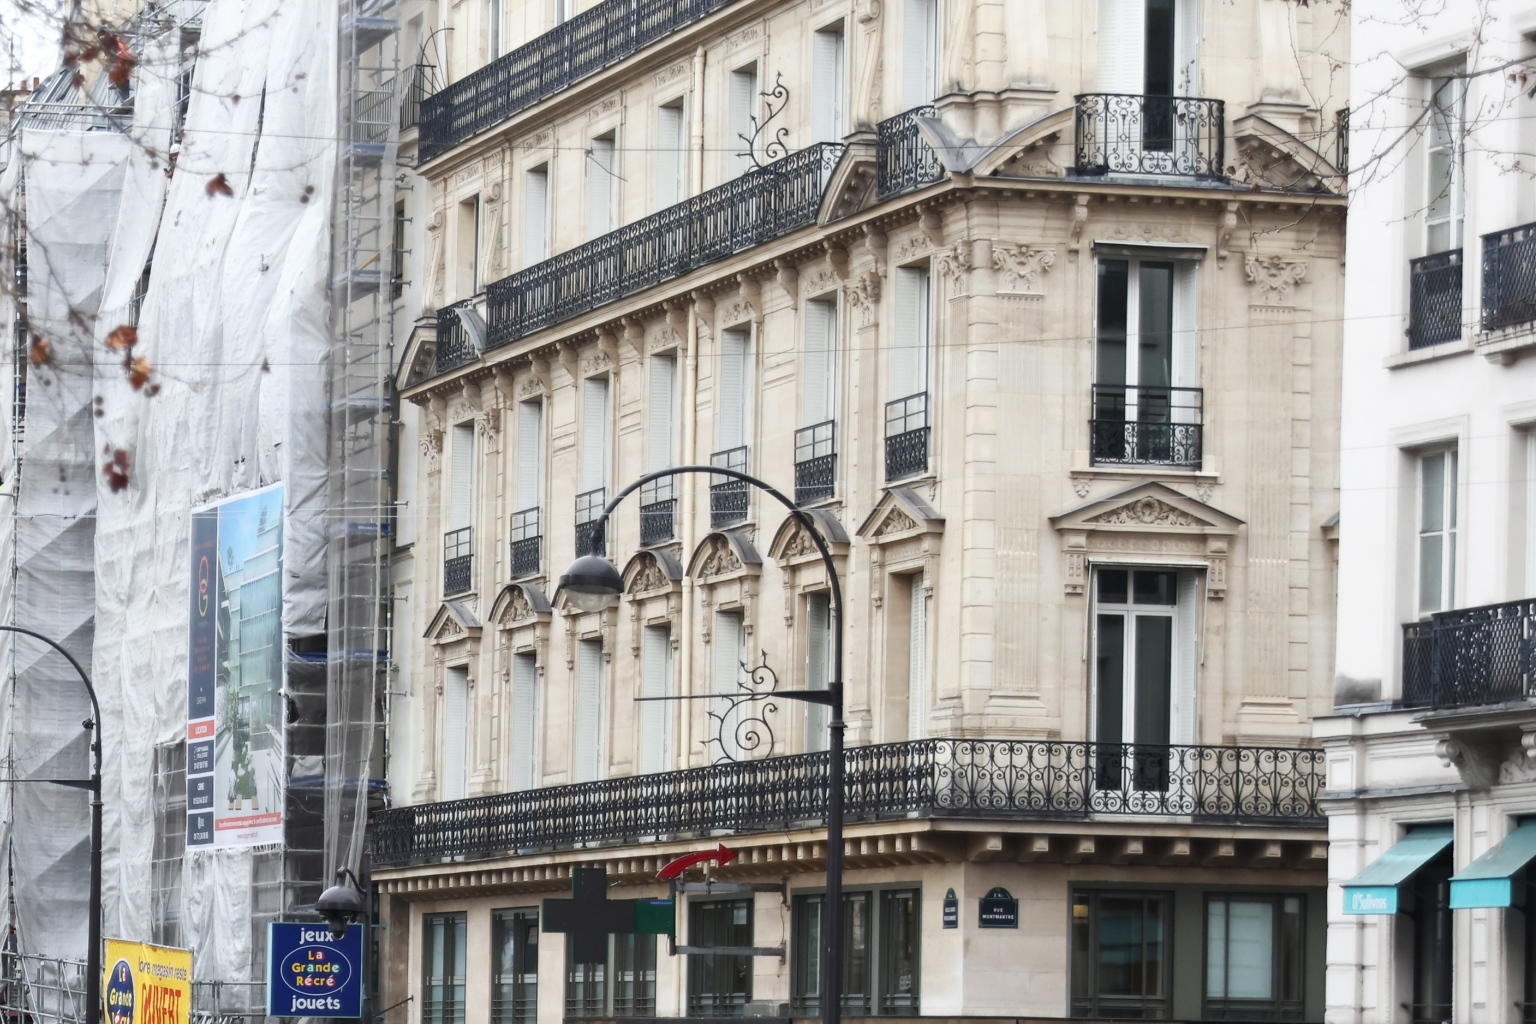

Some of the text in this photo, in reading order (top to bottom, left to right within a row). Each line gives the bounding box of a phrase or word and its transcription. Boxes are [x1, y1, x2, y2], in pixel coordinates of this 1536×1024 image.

[299, 927, 334, 945] jeux
[308, 950, 323, 961] La
[291, 962, 340, 973] Grande
[296, 974, 335, 986] Récré
[290, 994, 341, 1012] jouets
